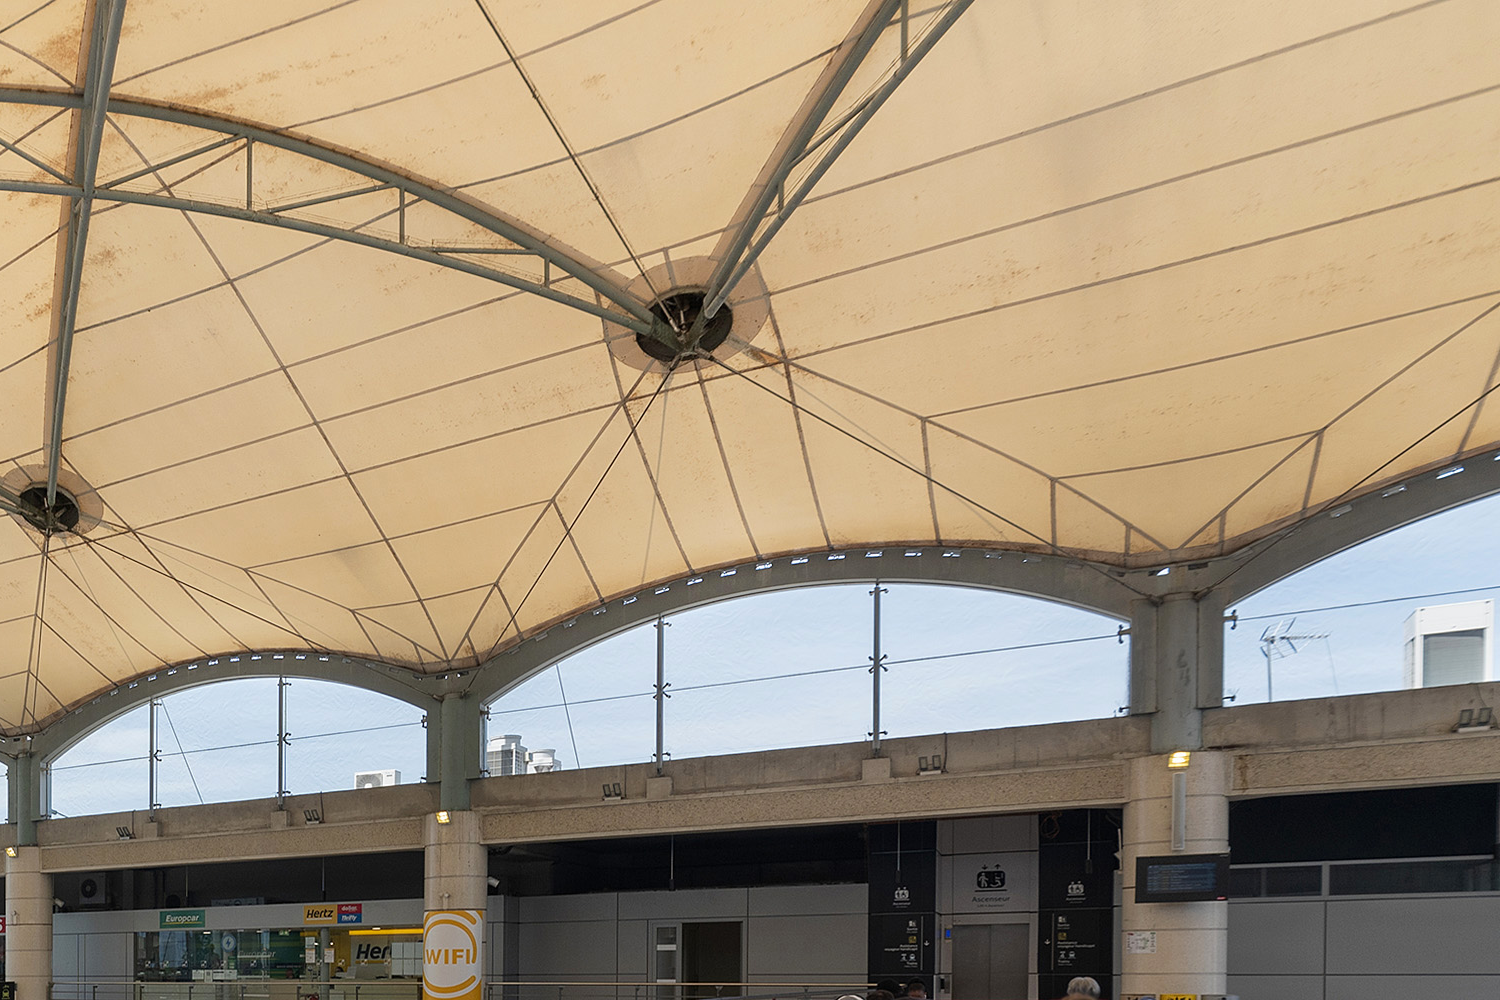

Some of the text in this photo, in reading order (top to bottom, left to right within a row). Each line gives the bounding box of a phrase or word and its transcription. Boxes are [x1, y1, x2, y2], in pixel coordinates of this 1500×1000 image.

[165, 914, 199, 924] Europcar
[306, 909, 334, 918] Hertz
[356, 944, 391, 959] Her
[425, 949, 470, 965] WIFI
